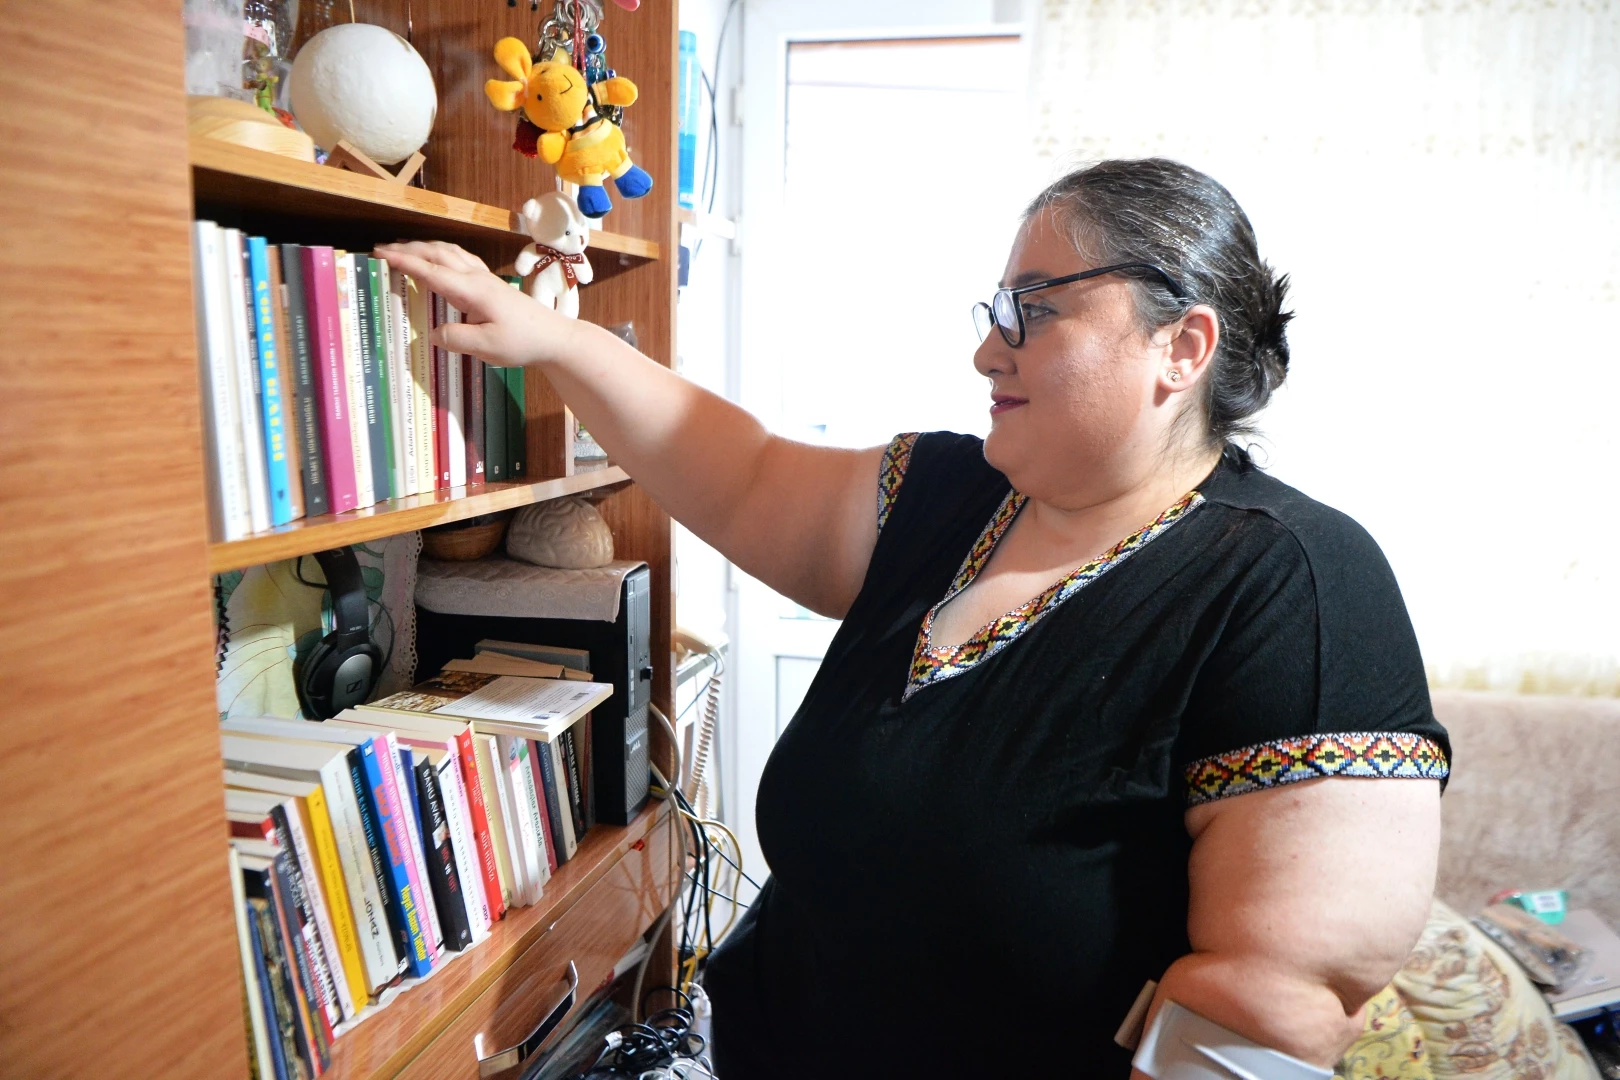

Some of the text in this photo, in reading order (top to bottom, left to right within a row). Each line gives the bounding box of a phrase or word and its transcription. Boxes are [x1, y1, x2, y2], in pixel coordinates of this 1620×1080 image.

[422, 768, 442, 828] BANU AVAR
[480, 830, 488, 850] RUH
[370, 846, 383, 877] Haldun
[400, 884, 414, 912] Hayat
